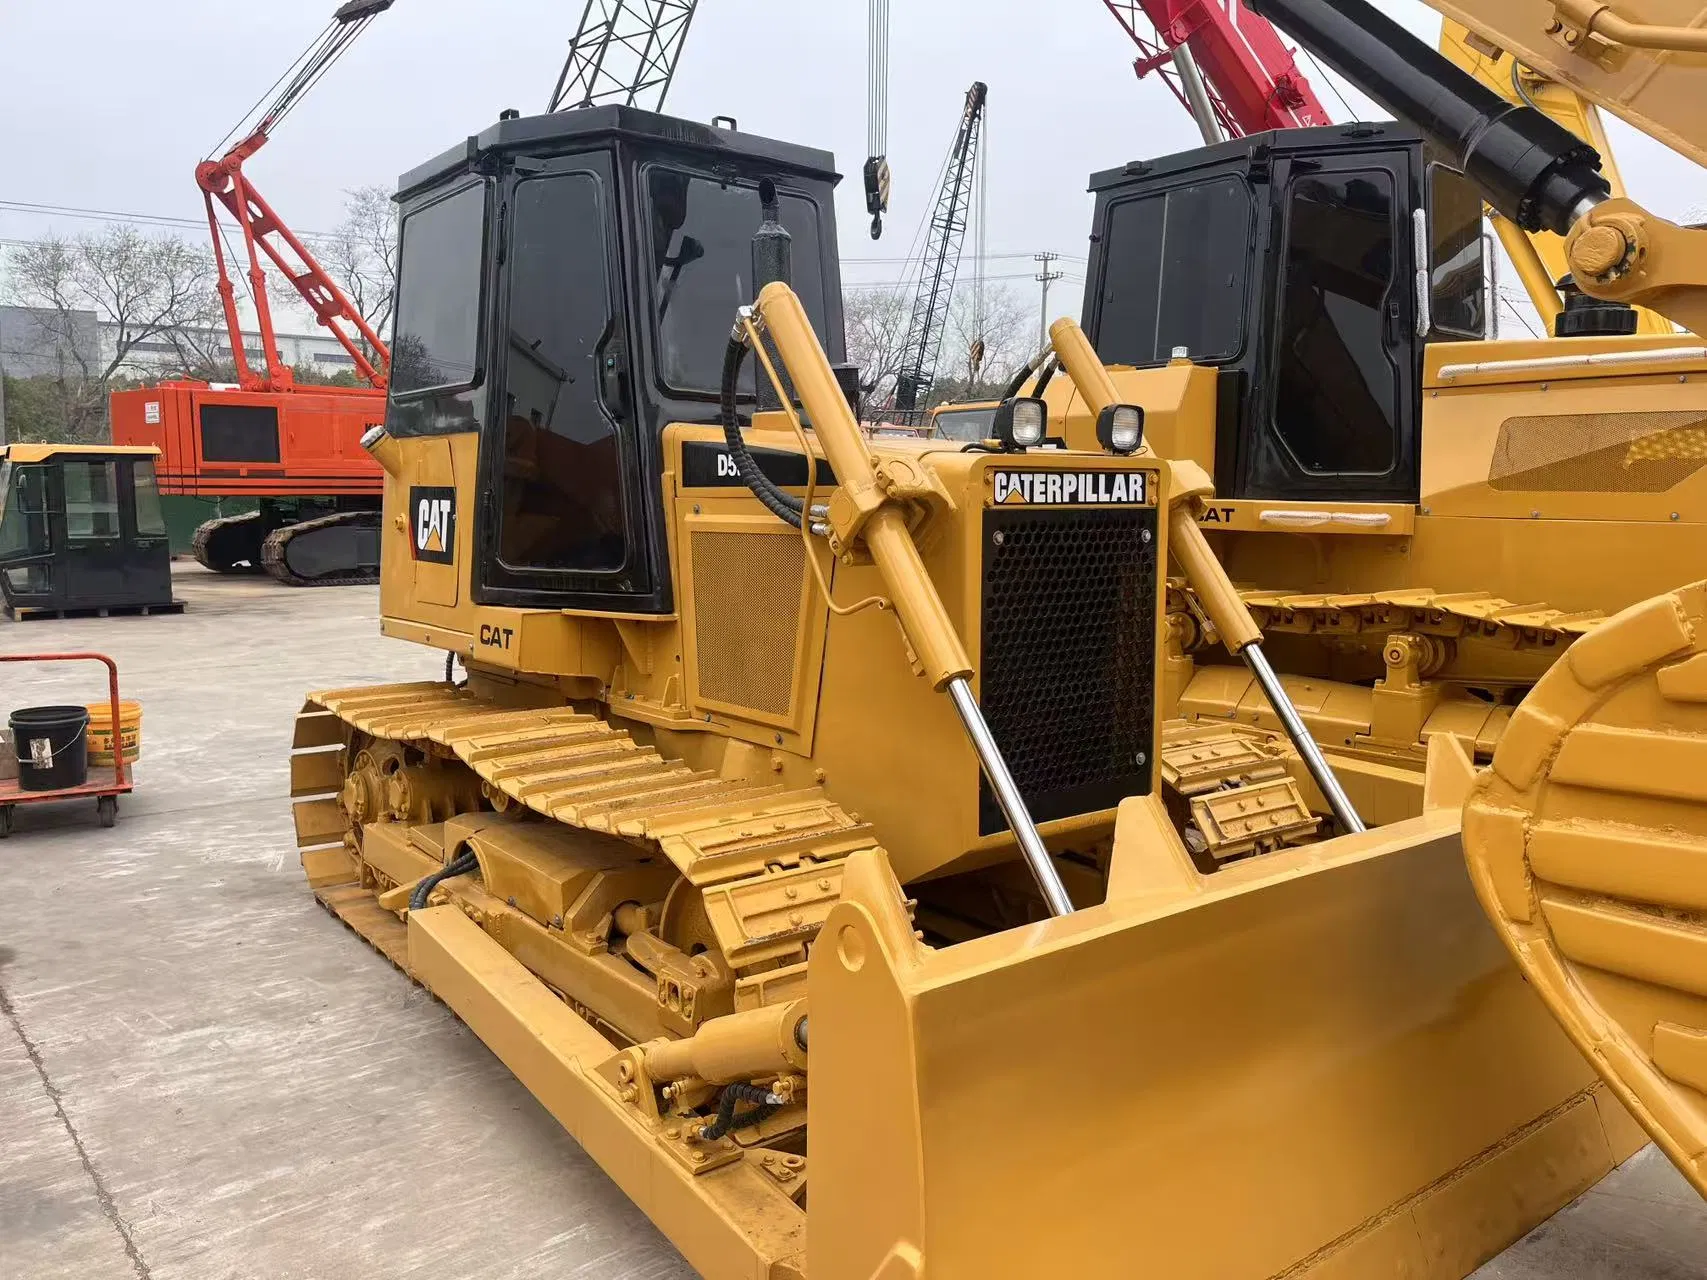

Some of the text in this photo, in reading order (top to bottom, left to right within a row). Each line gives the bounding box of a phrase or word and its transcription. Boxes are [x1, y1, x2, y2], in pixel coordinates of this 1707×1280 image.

[717, 453, 741, 477] D5
[994, 472, 1143, 503] CATERPILLAR
[417, 499, 451, 552] CAT
[1199, 507, 1235, 523] AT
[480, 624, 513, 649] CAT
